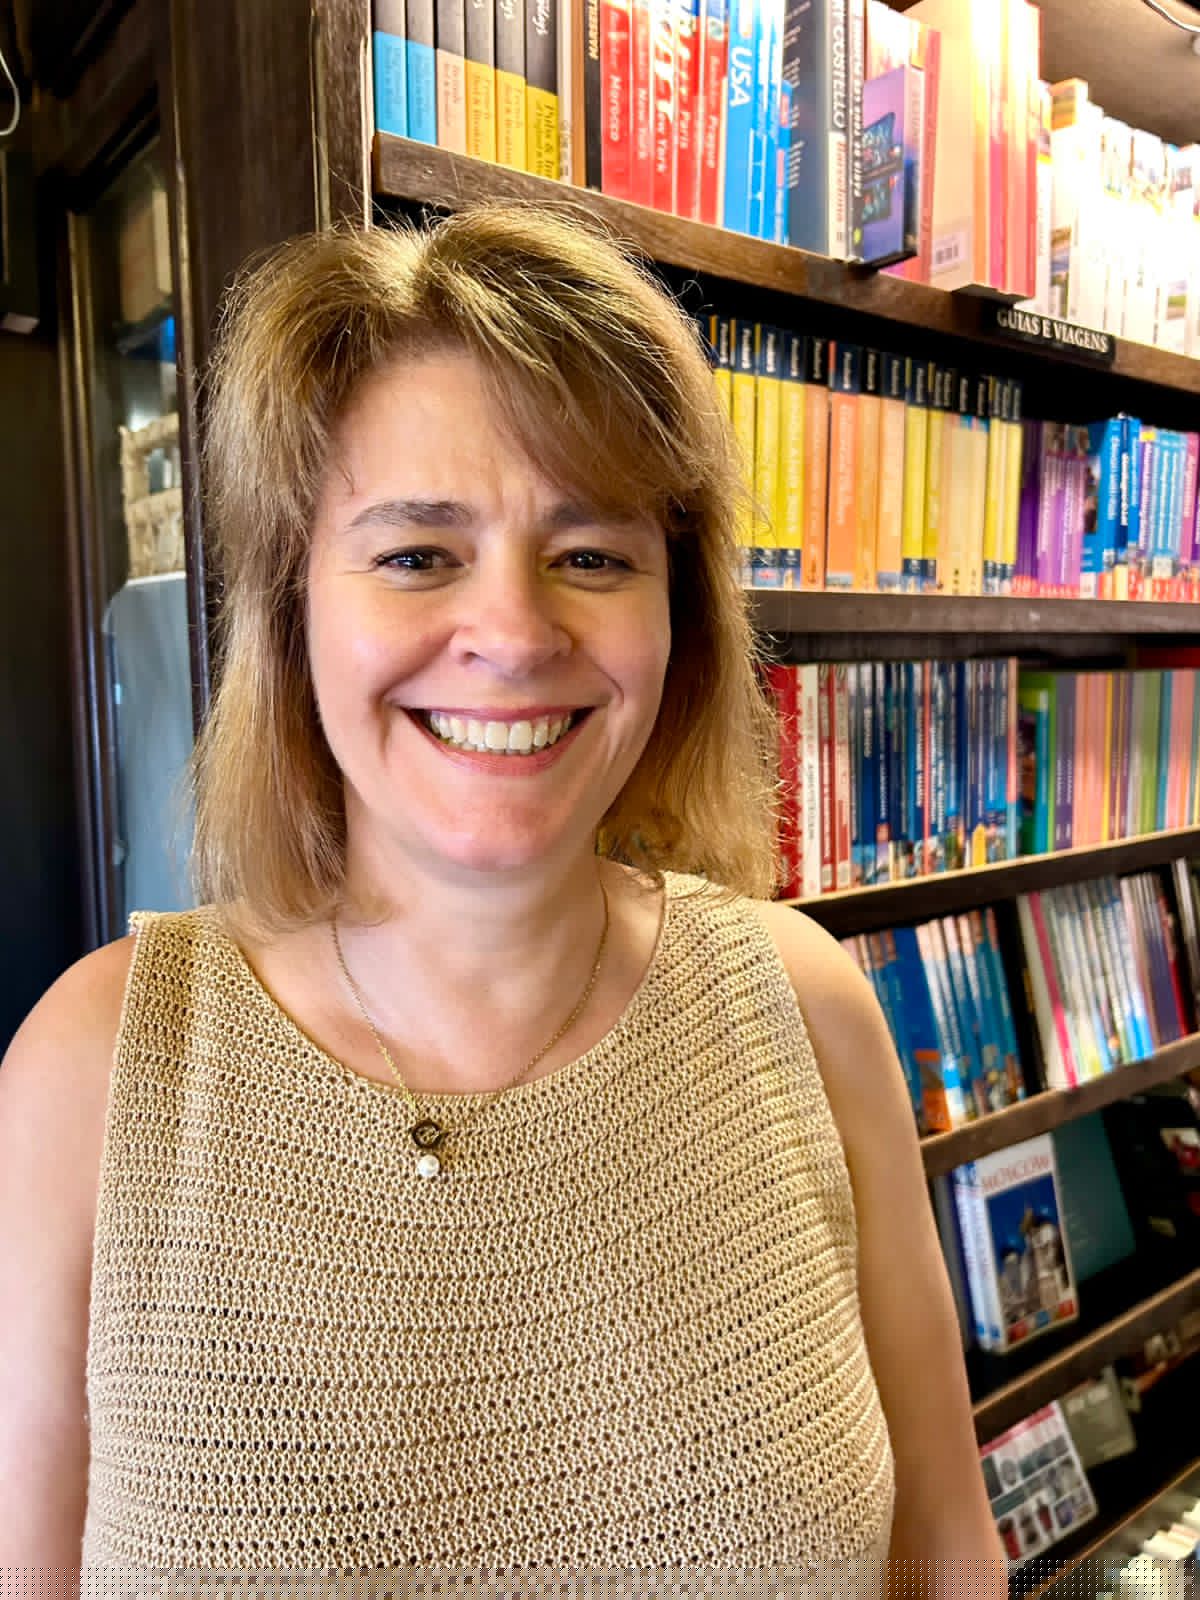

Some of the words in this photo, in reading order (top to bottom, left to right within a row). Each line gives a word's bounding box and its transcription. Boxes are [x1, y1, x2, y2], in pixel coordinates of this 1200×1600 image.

[729, 46, 753, 108] USA
[832, 26, 846, 128] COSTELLO
[610, 74, 622, 142] Morocco
[679, 109, 691, 150] Paris
[656, 138, 669, 173] York
[705, 114, 719, 169] Prague
[836, 142, 847, 223] Barcelona
[997, 309, 1041, 336] GUIAS
[1042, 318, 1053, 338] E
[1053, 321, 1110, 353] VIAGENS
